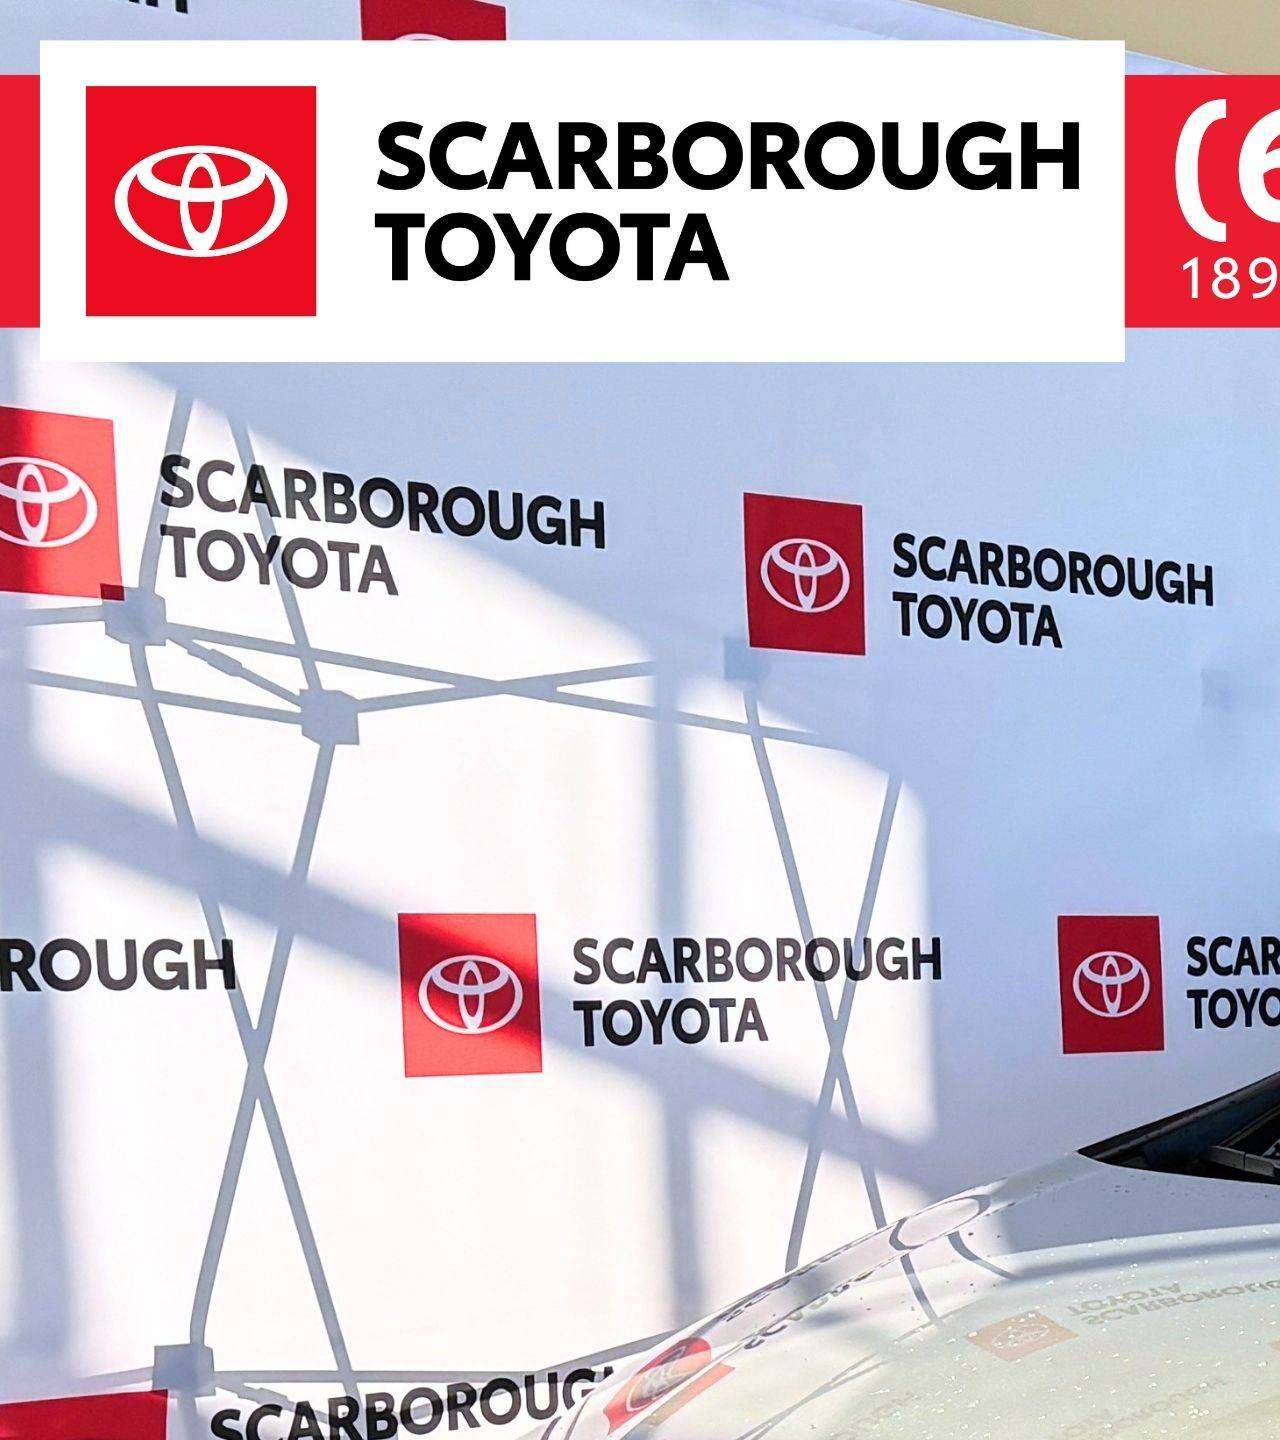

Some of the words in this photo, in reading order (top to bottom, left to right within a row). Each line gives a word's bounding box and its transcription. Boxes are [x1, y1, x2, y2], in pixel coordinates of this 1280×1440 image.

[160, 454, 606, 550] SCARBOROUGH
[160, 524, 399, 596] TOYOTA
[892, 532, 1214, 607] SCARBOROUGH
[892, 591, 1063, 649] TOYOTA
[573, 936, 942, 984] SCARBOROUGH
[572, 997, 769, 1047] TOYOTA
